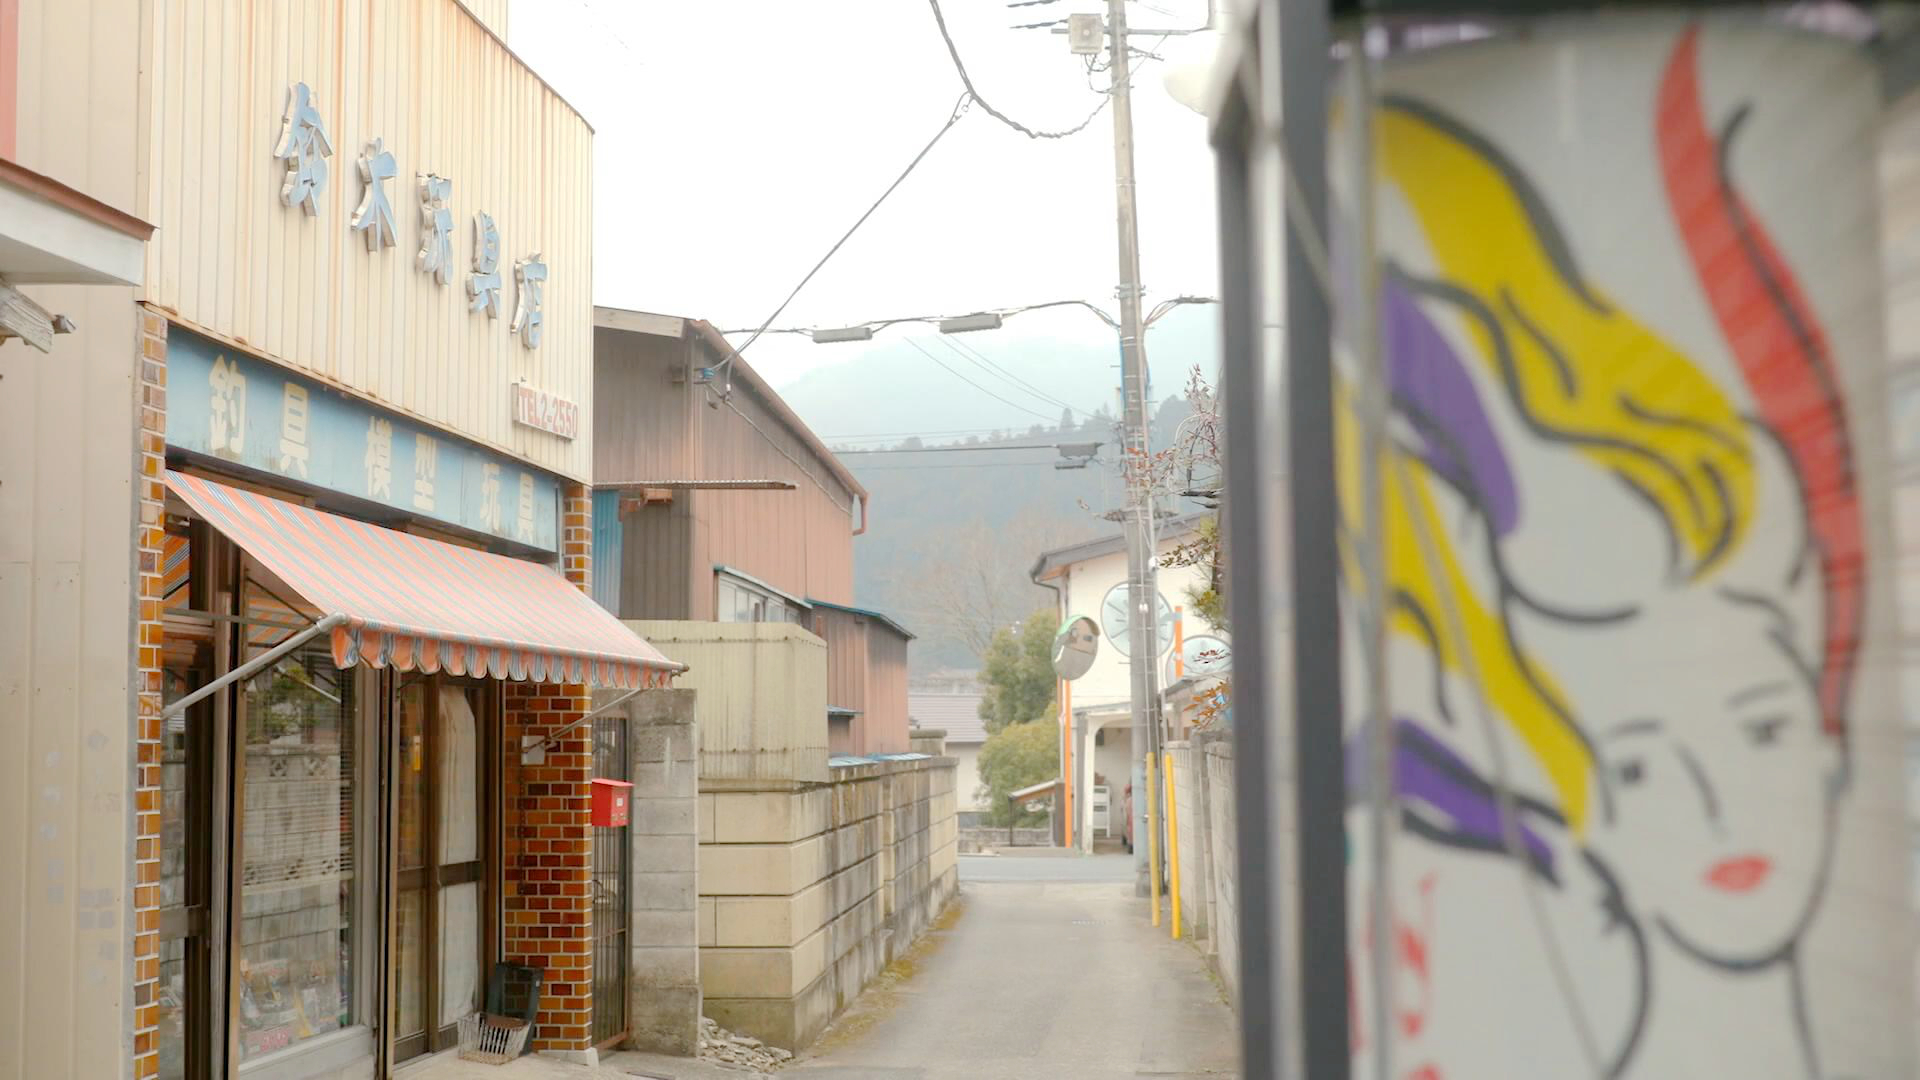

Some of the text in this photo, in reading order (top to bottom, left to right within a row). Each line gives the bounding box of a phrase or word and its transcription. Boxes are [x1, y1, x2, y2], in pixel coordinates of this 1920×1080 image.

[208, 354, 535, 545] 釣具 模型 玩具
